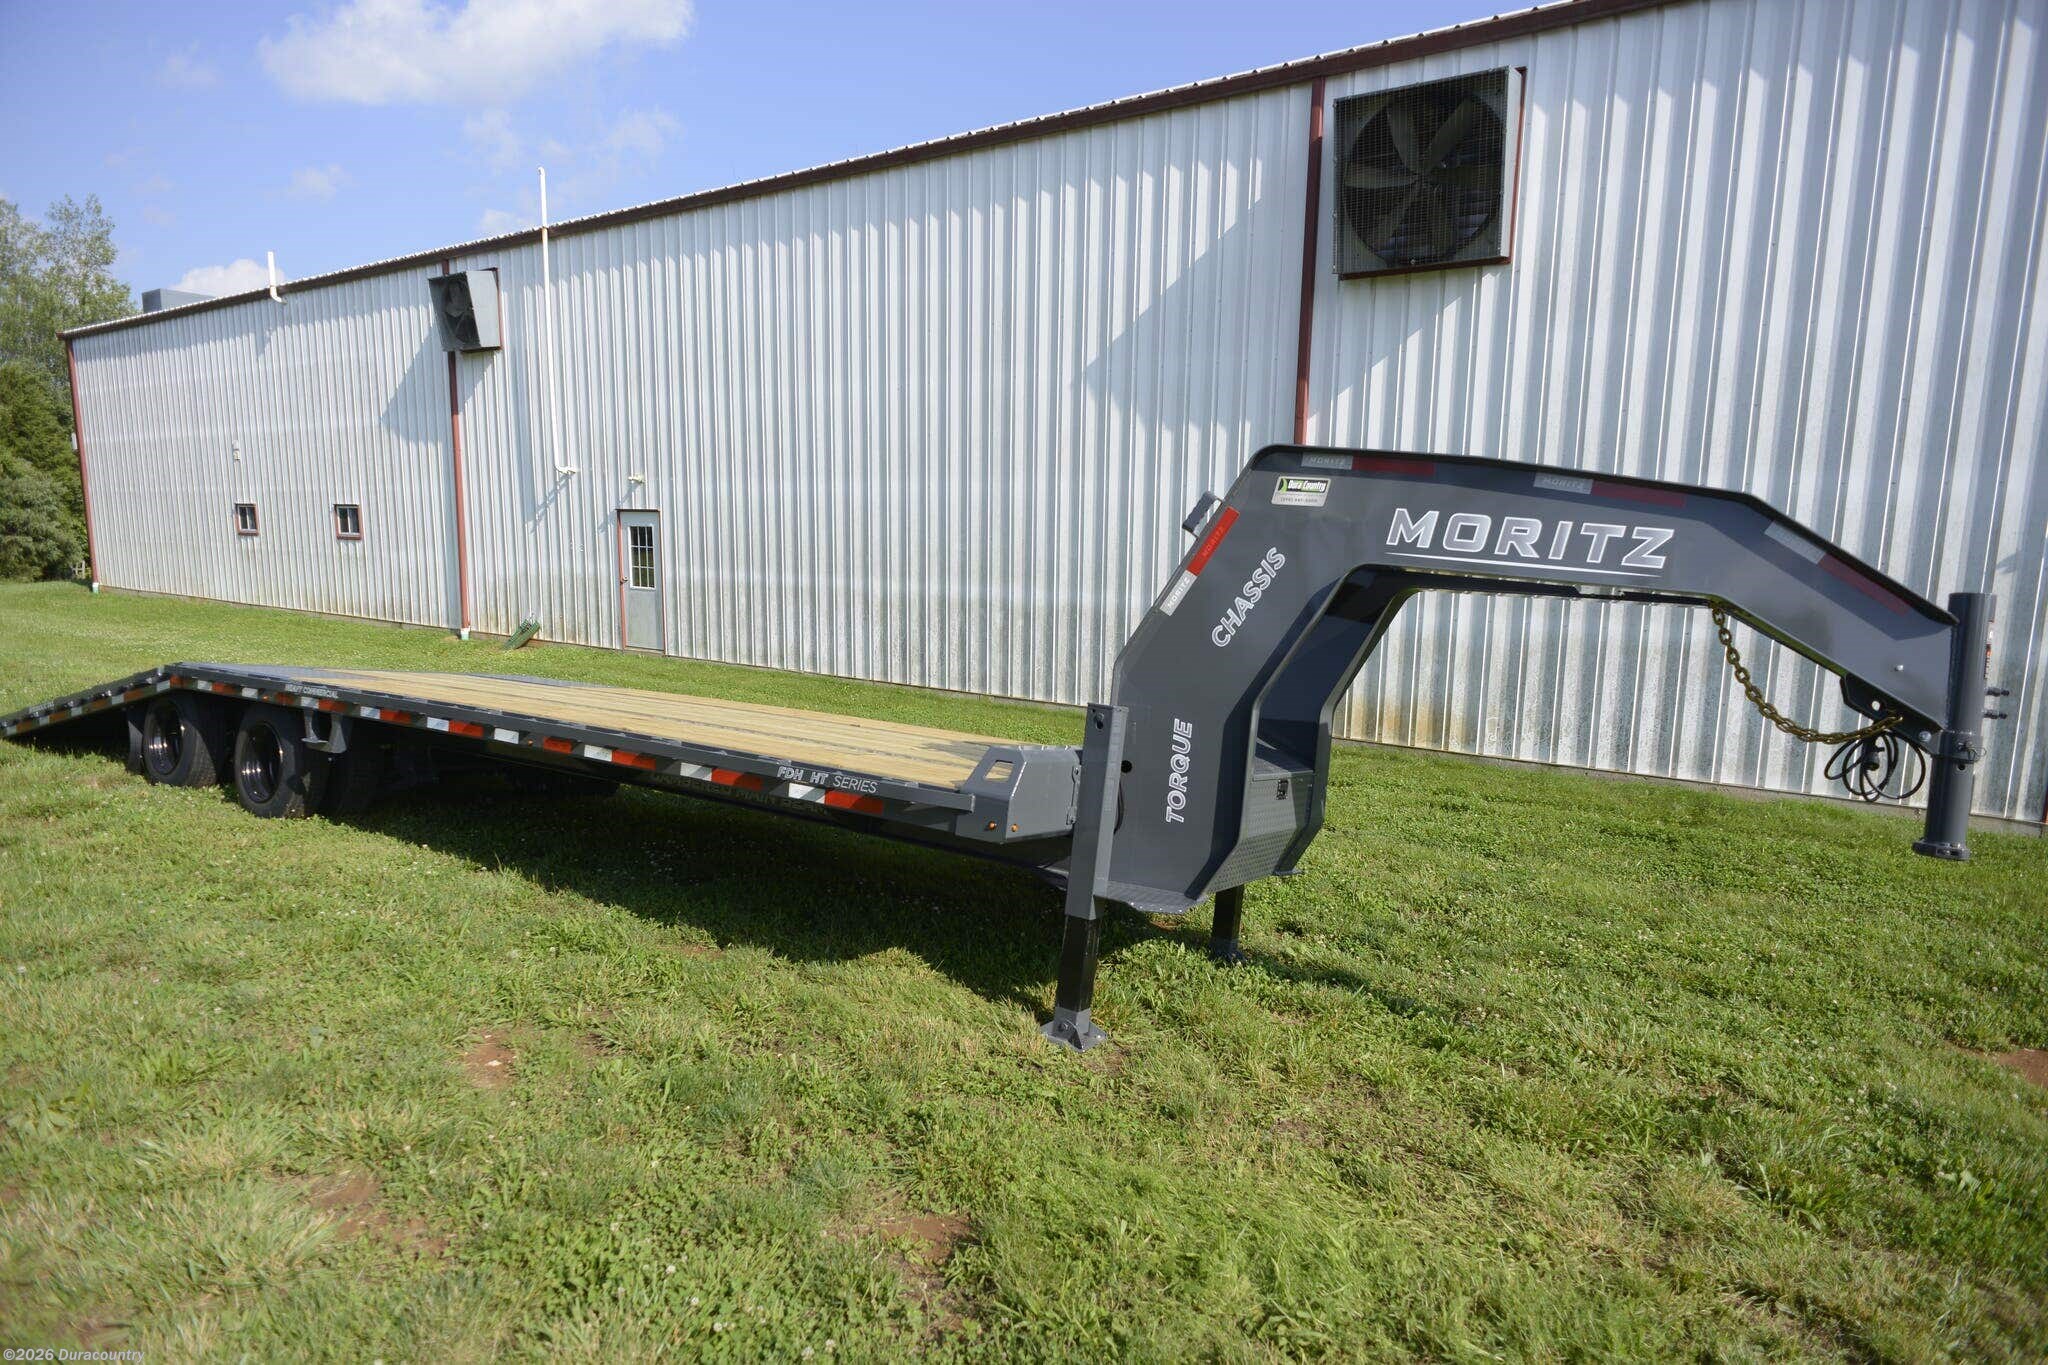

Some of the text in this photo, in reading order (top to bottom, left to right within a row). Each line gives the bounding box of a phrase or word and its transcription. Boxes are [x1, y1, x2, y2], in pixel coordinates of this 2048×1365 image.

[1385, 507, 1675, 569] MORITZ
[1211, 547, 1286, 647] CHASSIS
[777, 765, 878, 794] FDH HT SERIES
[1166, 718, 1193, 824] TORQUE
